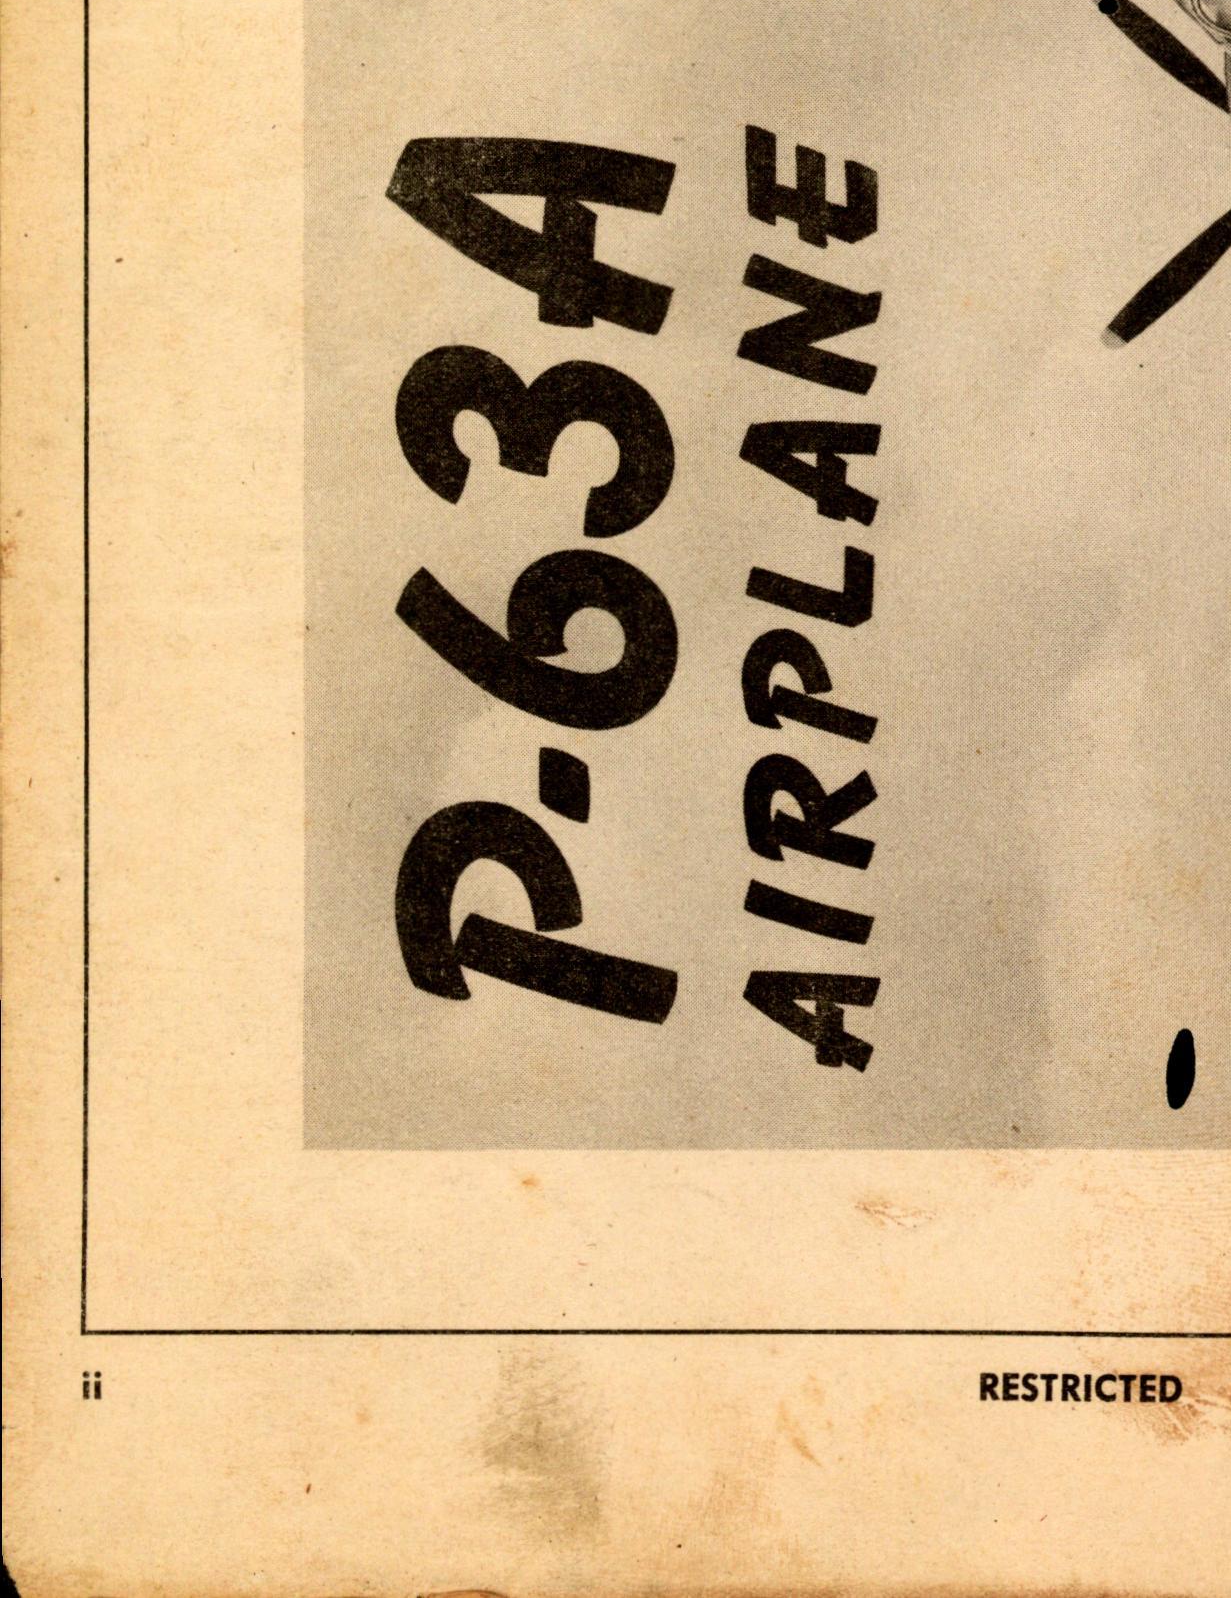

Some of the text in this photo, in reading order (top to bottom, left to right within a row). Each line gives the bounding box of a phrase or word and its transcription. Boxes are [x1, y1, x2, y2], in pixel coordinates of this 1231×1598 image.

[386, 138, 679, 1025] P-63A
[737, 124, 882, 1073] AIRPLANE
[82, 1371, 102, 1400] ii
[979, 1372, 1183, 1404] RESTRICTED
